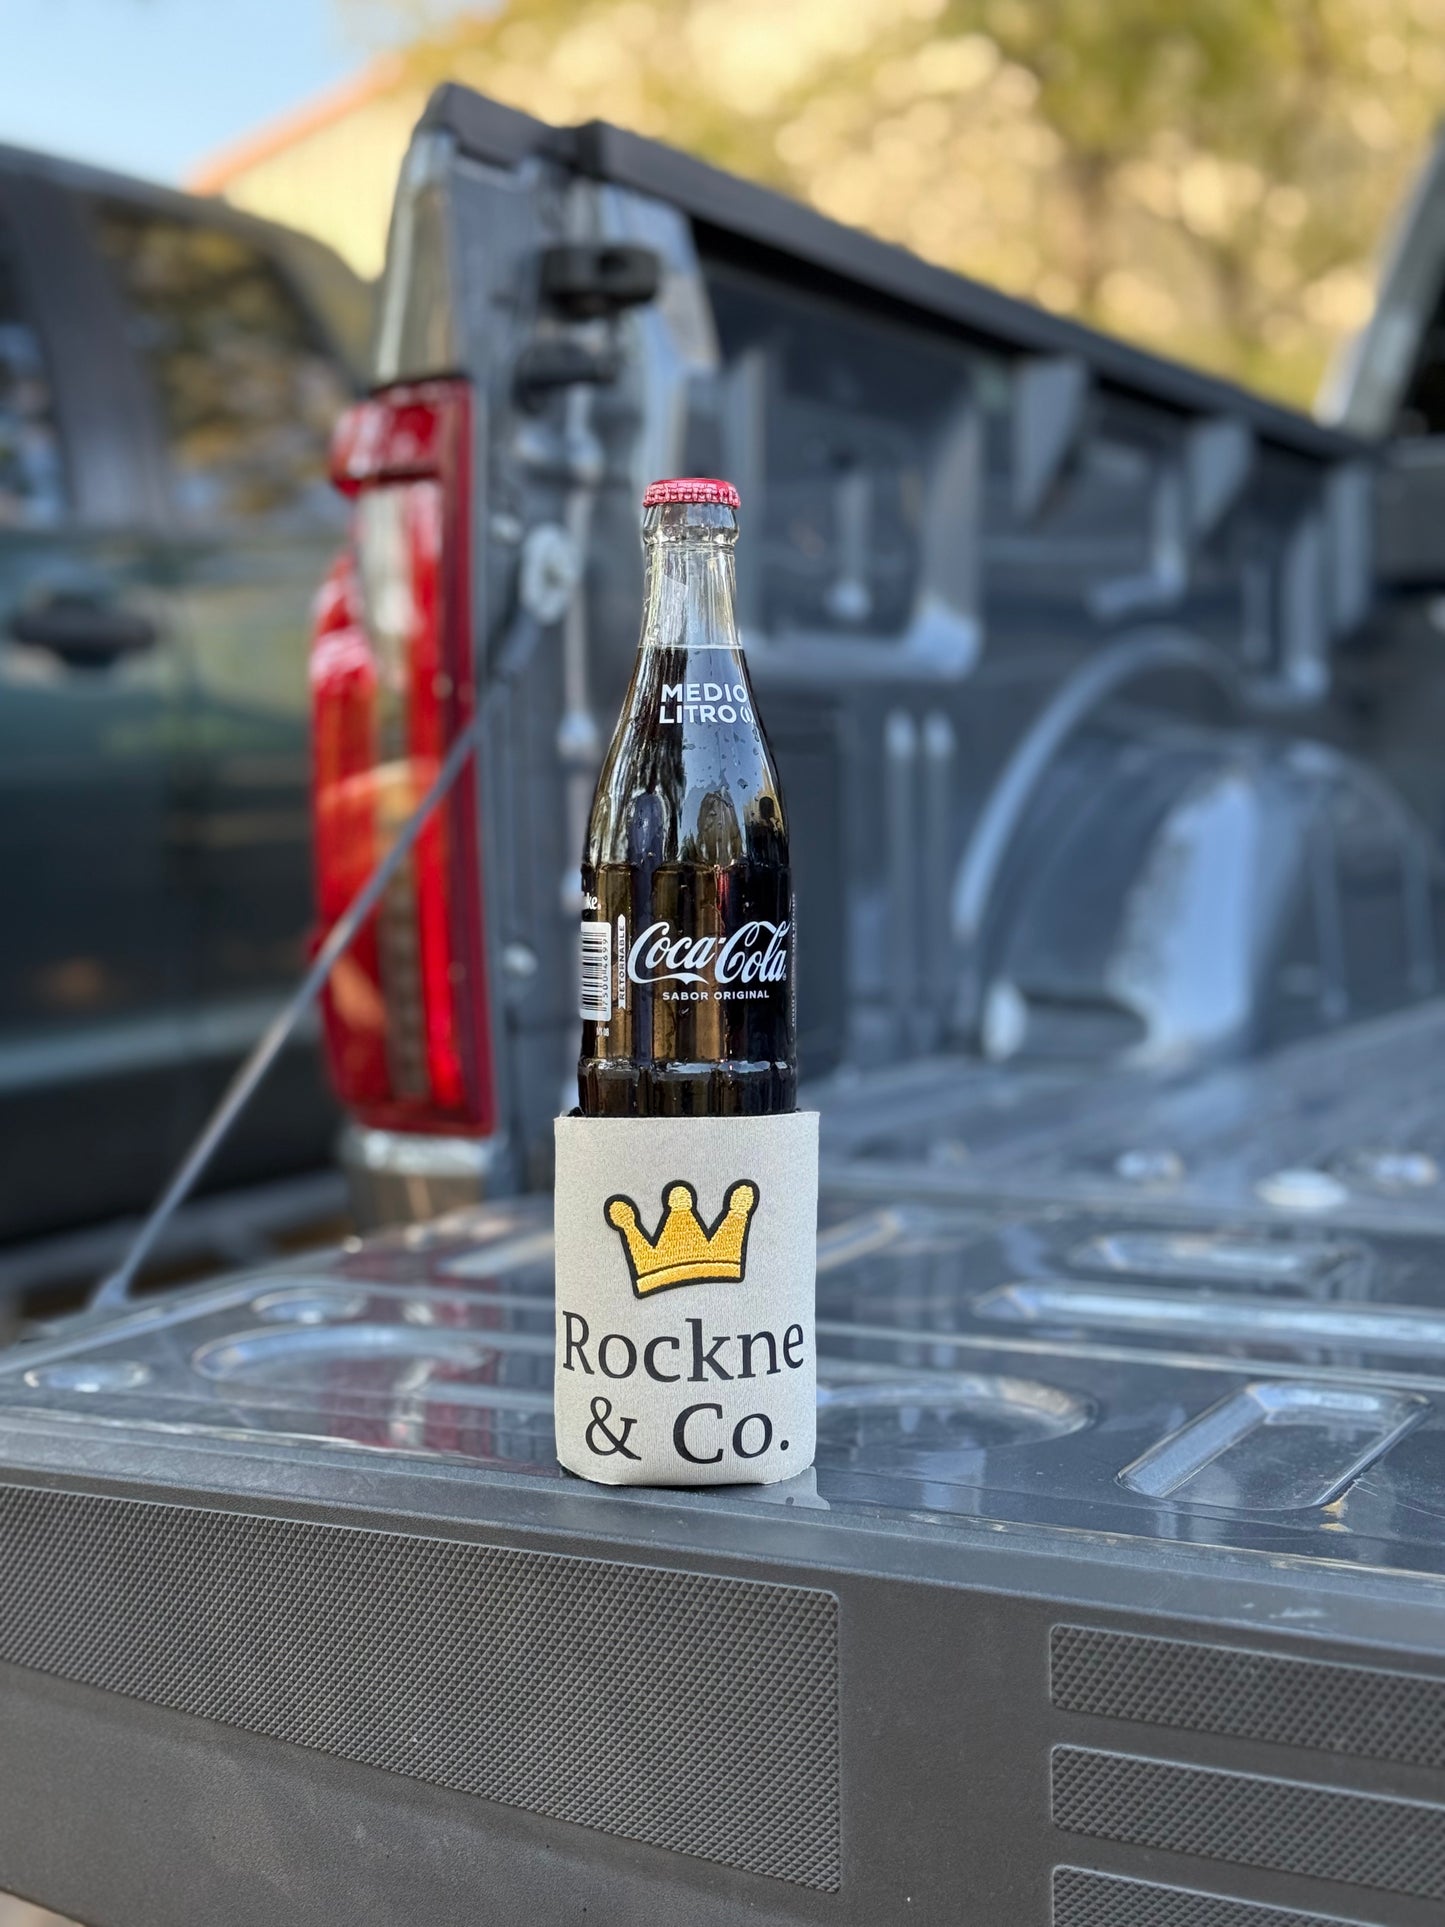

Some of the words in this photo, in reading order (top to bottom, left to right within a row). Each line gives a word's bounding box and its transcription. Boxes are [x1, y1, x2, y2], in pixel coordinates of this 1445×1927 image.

[661, 683, 748, 702] MEDIO
[659, 705, 737, 723] LITRO
[627, 920, 790, 985] Coca-Cola
[662, 991, 709, 1001] SABOR
[713, 990, 770, 1000] ORIGINAL
[562, 1310, 804, 1383] Rockne
[585, 1396, 642, 1460] &
[672, 1402, 790, 1465] Co.
